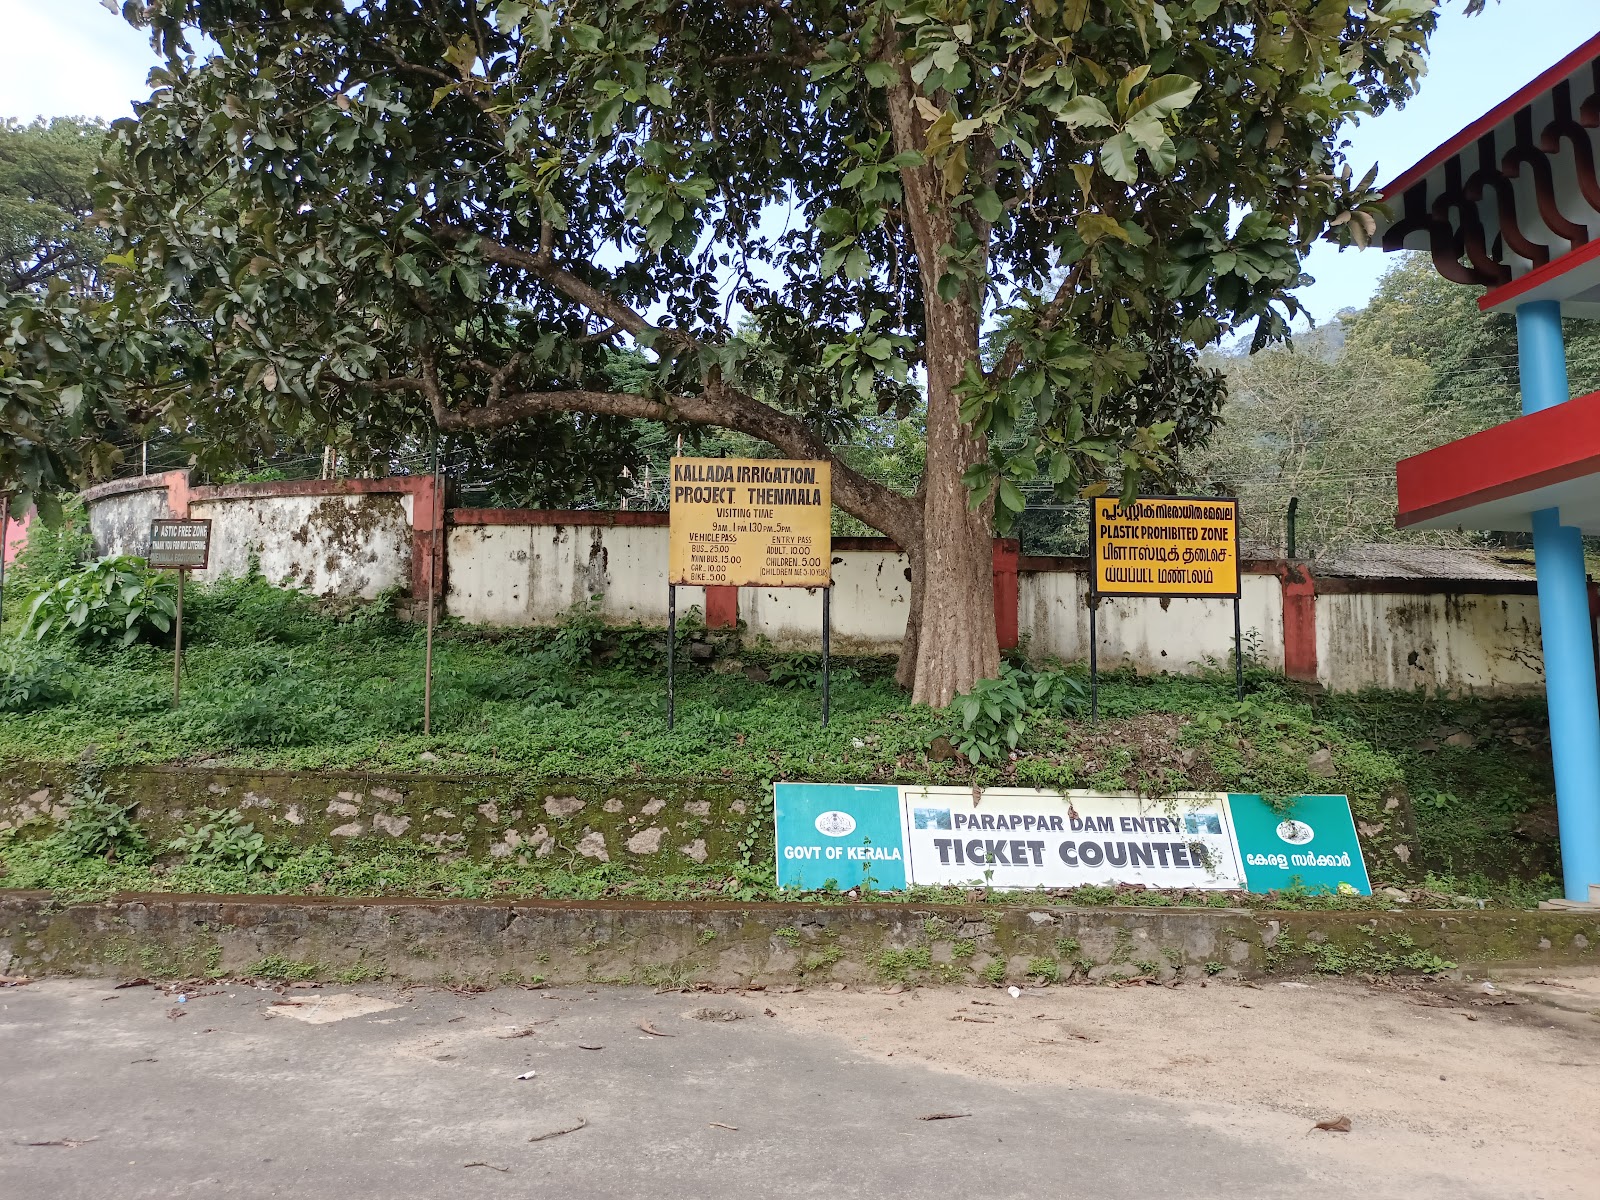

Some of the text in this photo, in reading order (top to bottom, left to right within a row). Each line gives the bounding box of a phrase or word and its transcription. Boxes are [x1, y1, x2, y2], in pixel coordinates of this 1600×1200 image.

[674, 464, 734, 482] KALLADA
[748, 488, 821, 506] THENMALA
[716, 508, 774, 519] VISITING TIME
[1156, 504, 1203, 519] നിരോധിത
[1203, 506, 1233, 520] മേഖല
[177, 525, 192, 537] FREE
[689, 532, 737, 543] VEHICLE PASS
[1100, 525, 1228, 541] PLASTIC PROHIBITED ZONE
[771, 536, 812, 544] ENTRY PASS
[1103, 542, 1180, 563] பிளாஸ்டிக்
[1158, 566, 1214, 584] மண்டலம்
[954, 813, 1182, 834] PARAPPAR DAM ENTRY
[784, 845, 901, 861] GOVT OF KERALA
[934, 838, 1045, 867] TICKET
[1246, 851, 1351, 869] കേരള സർക്കാർ
